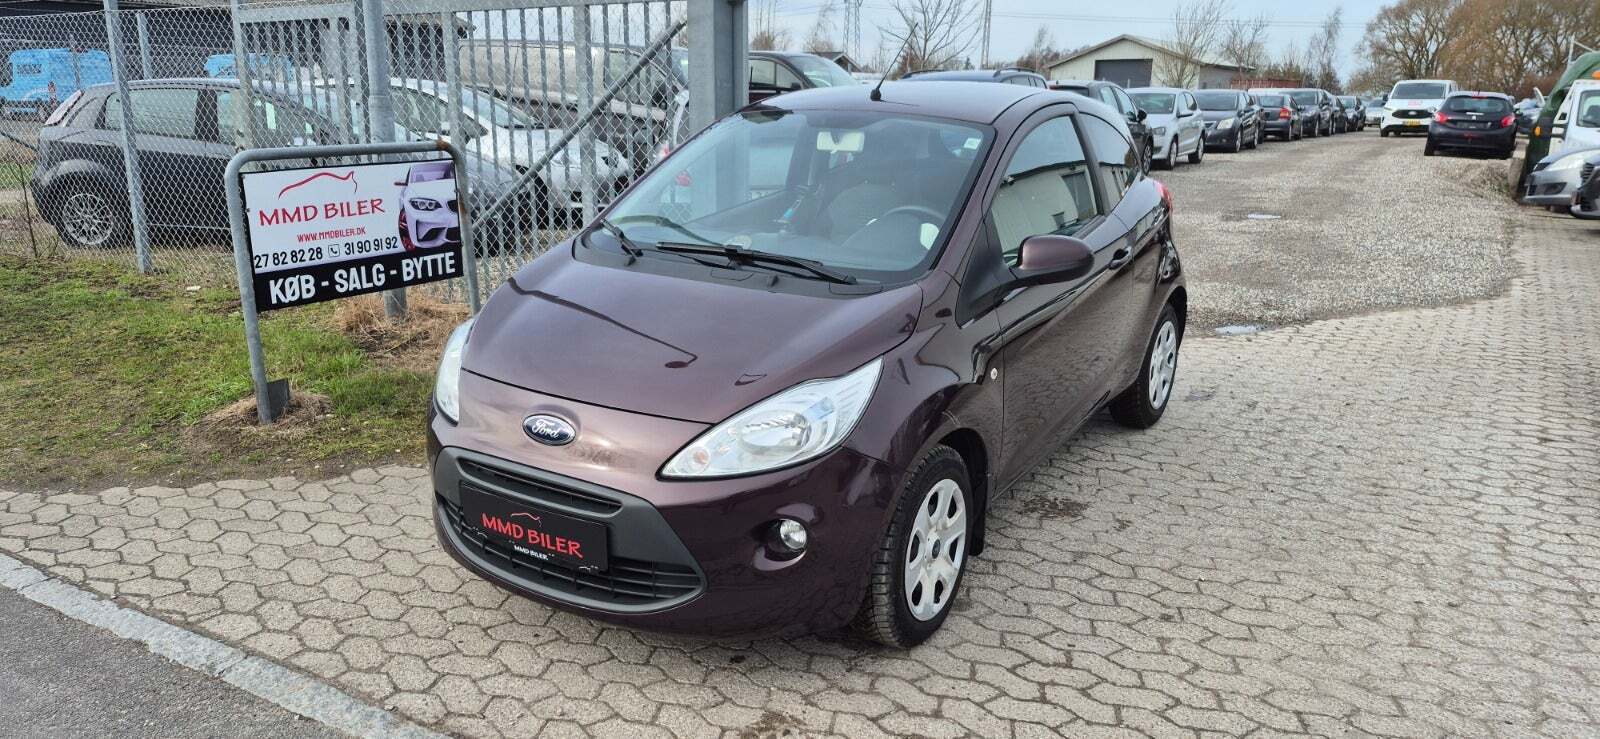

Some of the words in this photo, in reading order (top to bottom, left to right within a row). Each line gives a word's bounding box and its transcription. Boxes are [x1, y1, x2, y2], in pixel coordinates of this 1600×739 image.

[259, 205, 318, 226] MMD
[324, 199, 385, 219] BILER
[297, 227, 366, 242] WWW.MMDBILER.DK
[254, 254, 269, 268] 27
[272, 251, 288, 266] 82
[290, 249, 306, 264] 82
[308, 246, 323, 261] 28
[344, 242, 355, 256] 31
[357, 240, 371, 253] 90
[374, 238, 383, 251] 91
[386, 236, 398, 249] 92
[269, 275, 316, 305] KØB
[334, 263, 386, 294] SALG
[402, 252, 456, 282] BYTTE
[531, 418, 560, 439] Ford
[482, 512, 524, 539] MMD
[527, 529, 583, 559] BILER
[514, 544, 530, 555] MMD
[530, 549, 549, 561] BILER
